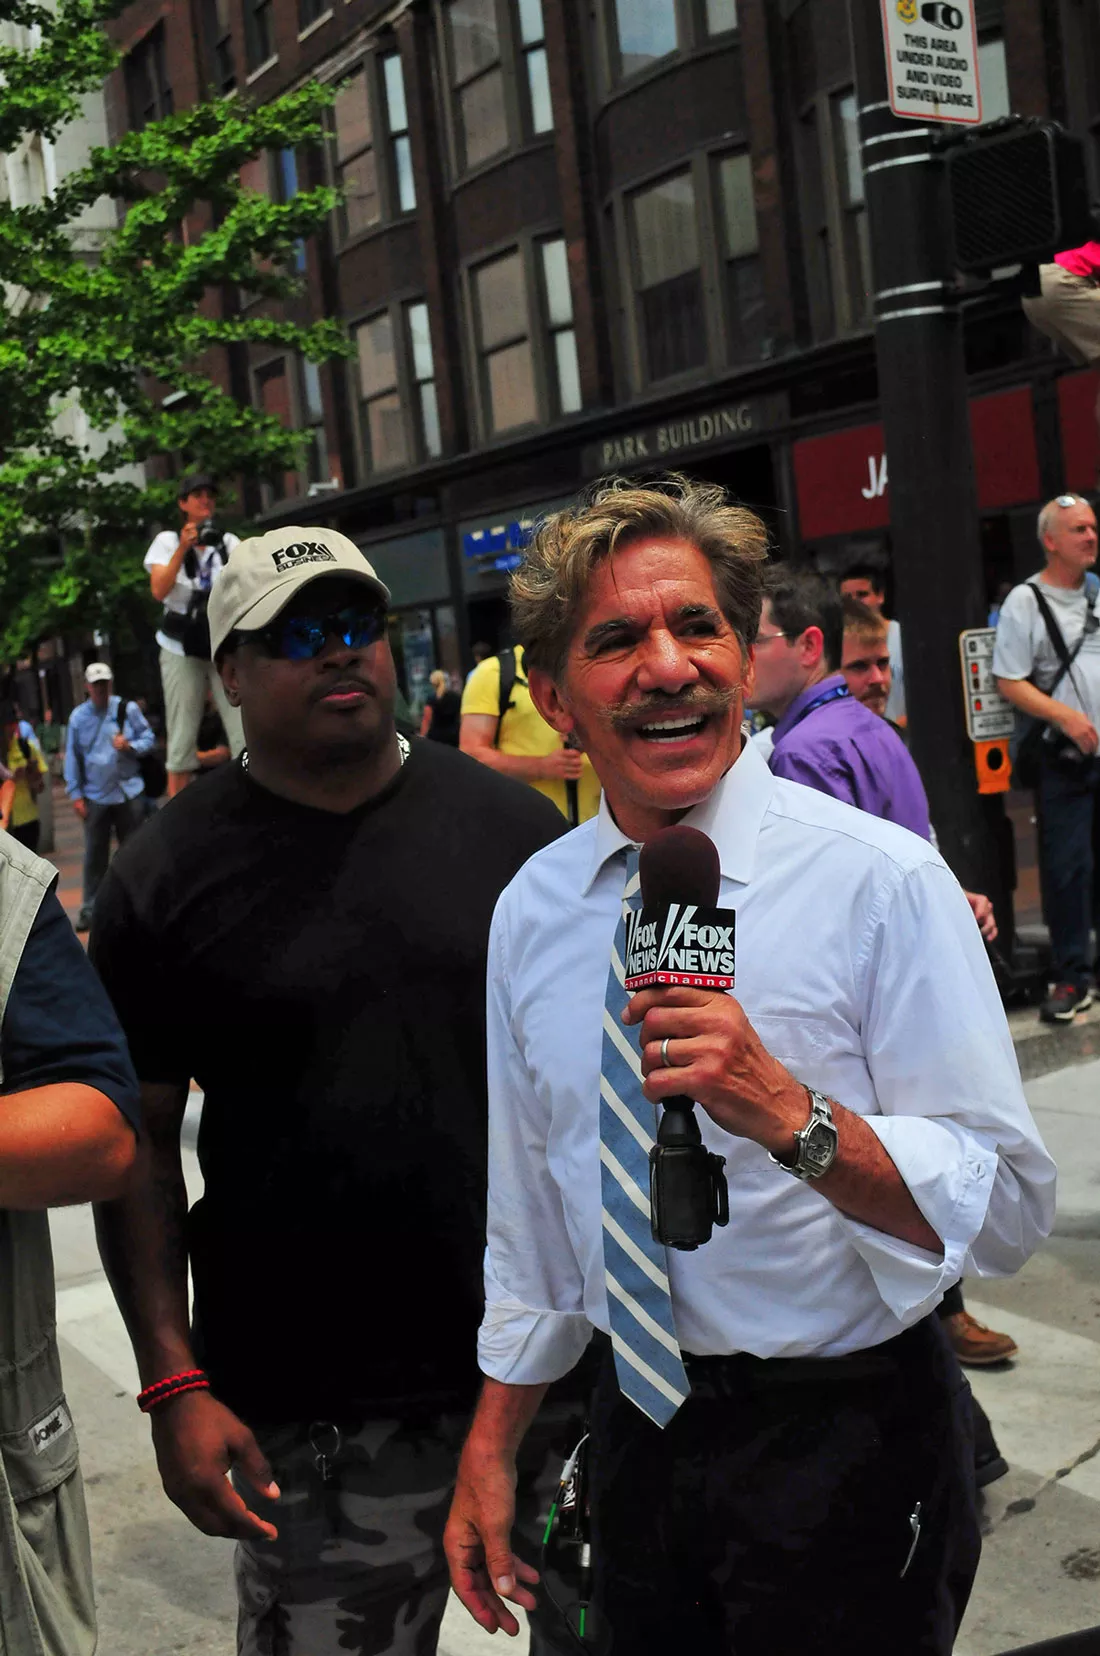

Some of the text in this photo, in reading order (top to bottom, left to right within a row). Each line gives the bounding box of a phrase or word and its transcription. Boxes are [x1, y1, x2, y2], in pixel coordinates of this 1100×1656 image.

[904, 33, 957, 53] THIS AREA
[896, 49, 968, 72] UNDER AUDIO
[906, 69, 963, 89] AND VIDEO
[602, 404, 752, 465] PARK BUILDING
[271, 541, 322, 565] FOX
[635, 921, 657, 951] FOX
[683, 923, 734, 950] FOX
[629, 947, 657, 976] NEWS
[668, 948, 735, 974] NEWS
[625, 973, 657, 990] channel
[657, 974, 734, 988] channel
